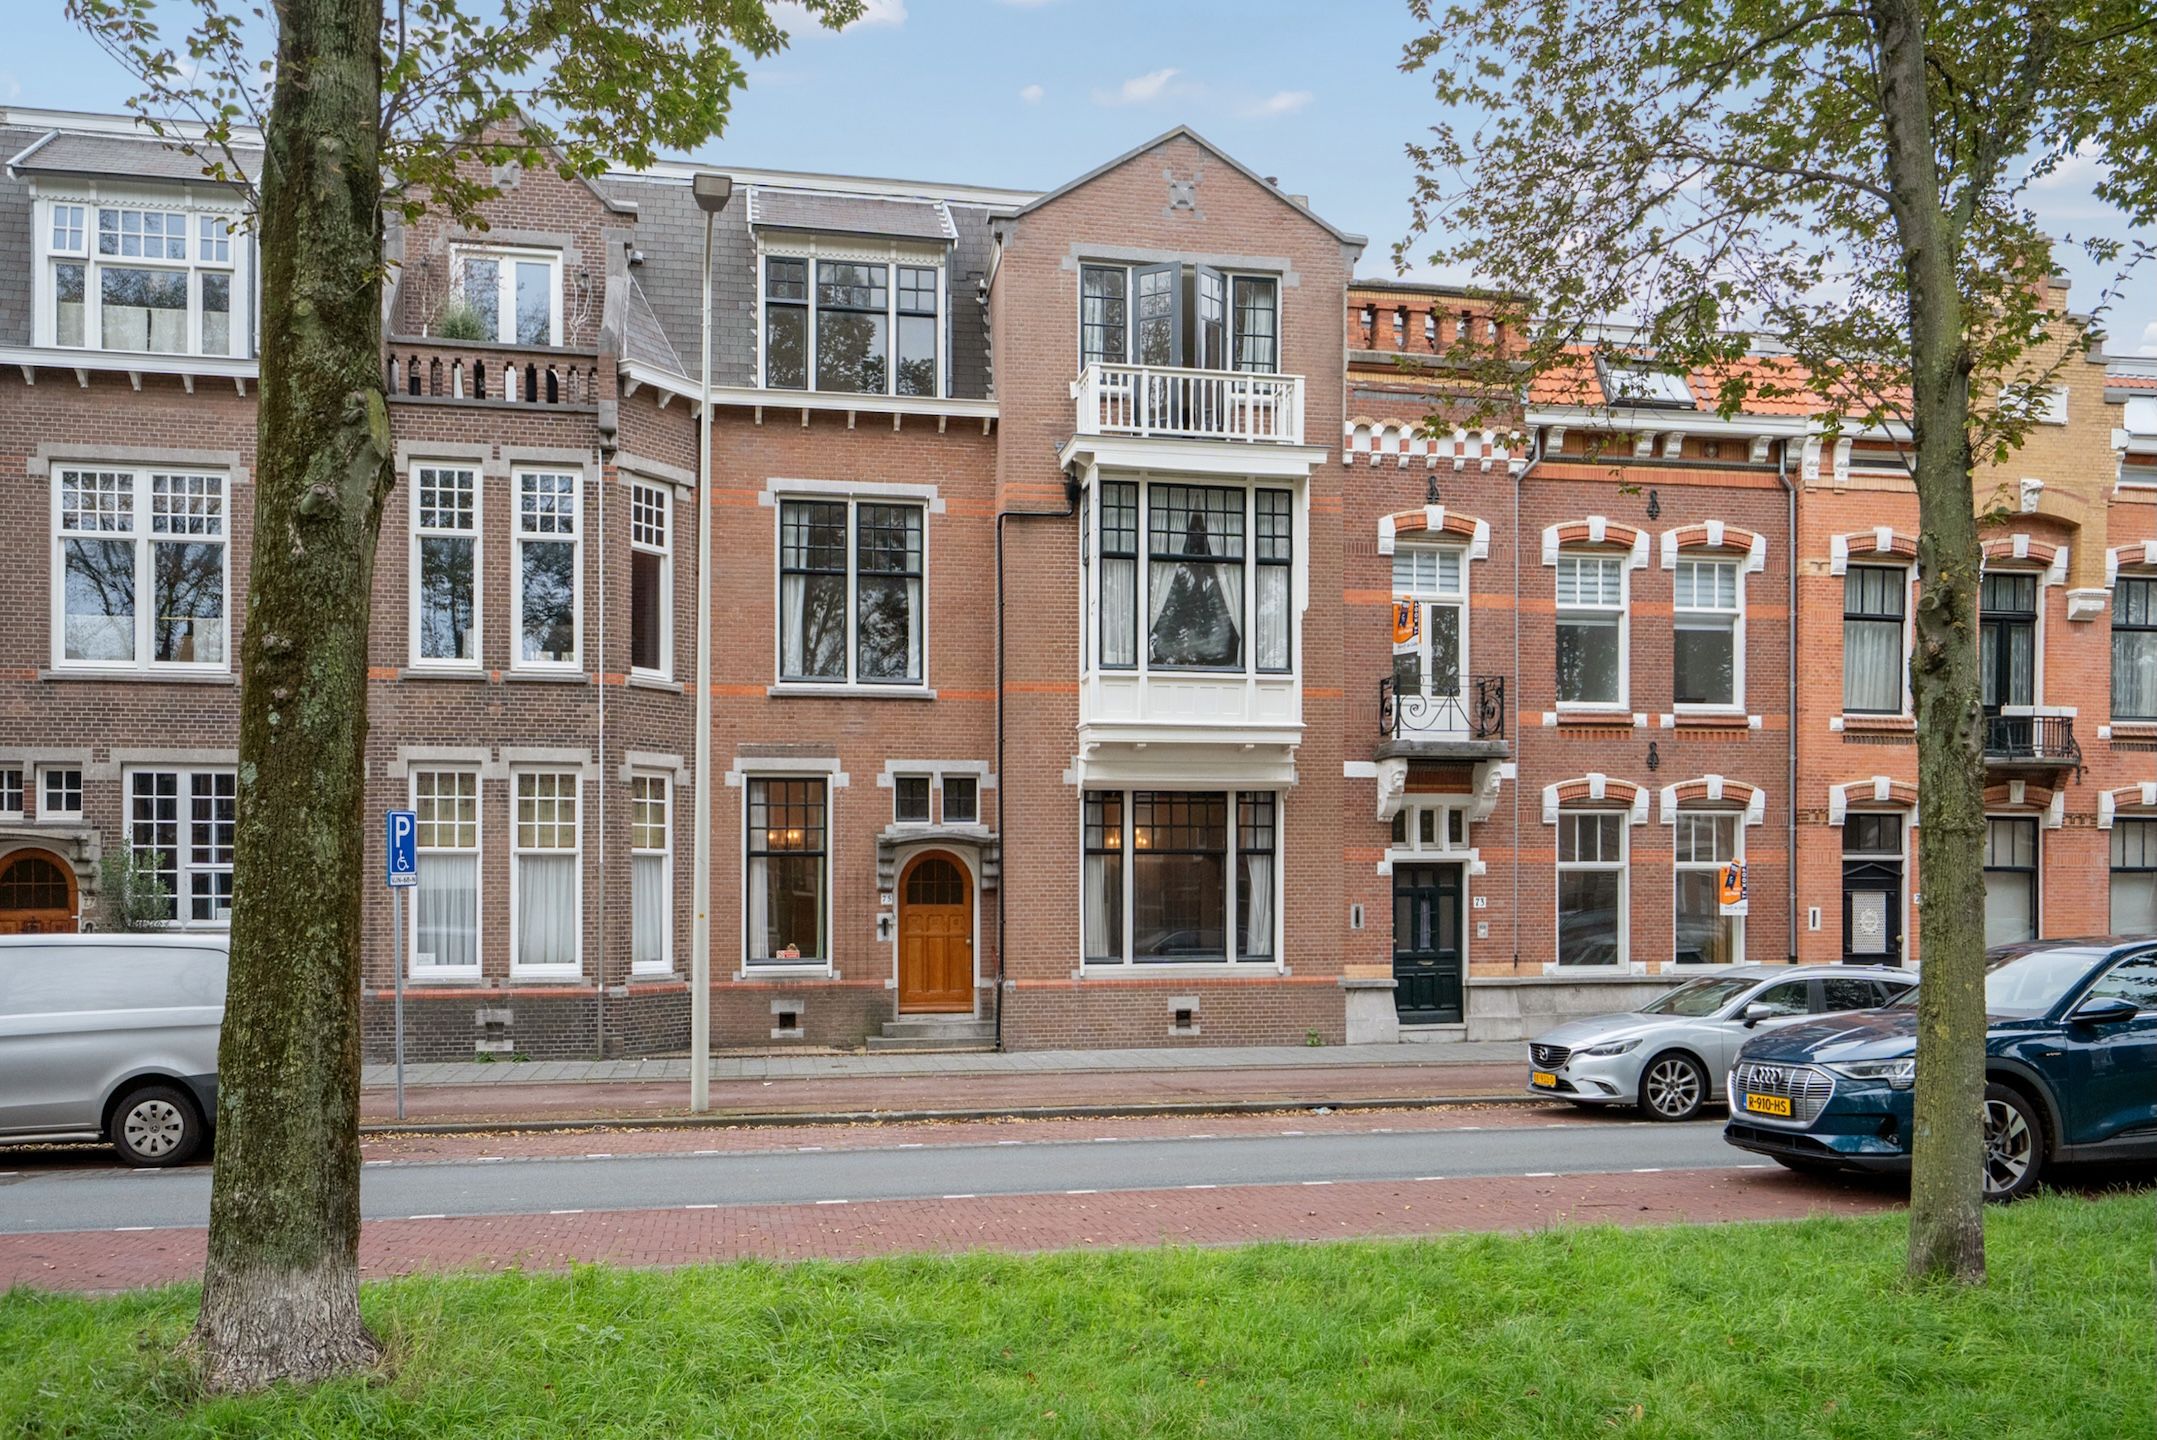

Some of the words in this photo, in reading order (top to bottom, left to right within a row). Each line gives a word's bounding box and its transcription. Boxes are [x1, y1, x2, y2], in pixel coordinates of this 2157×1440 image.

[395, 815, 411, 848] P
[1475, 897, 1485, 907] 73
[1748, 1096, 1787, 1113] R-910-HS
